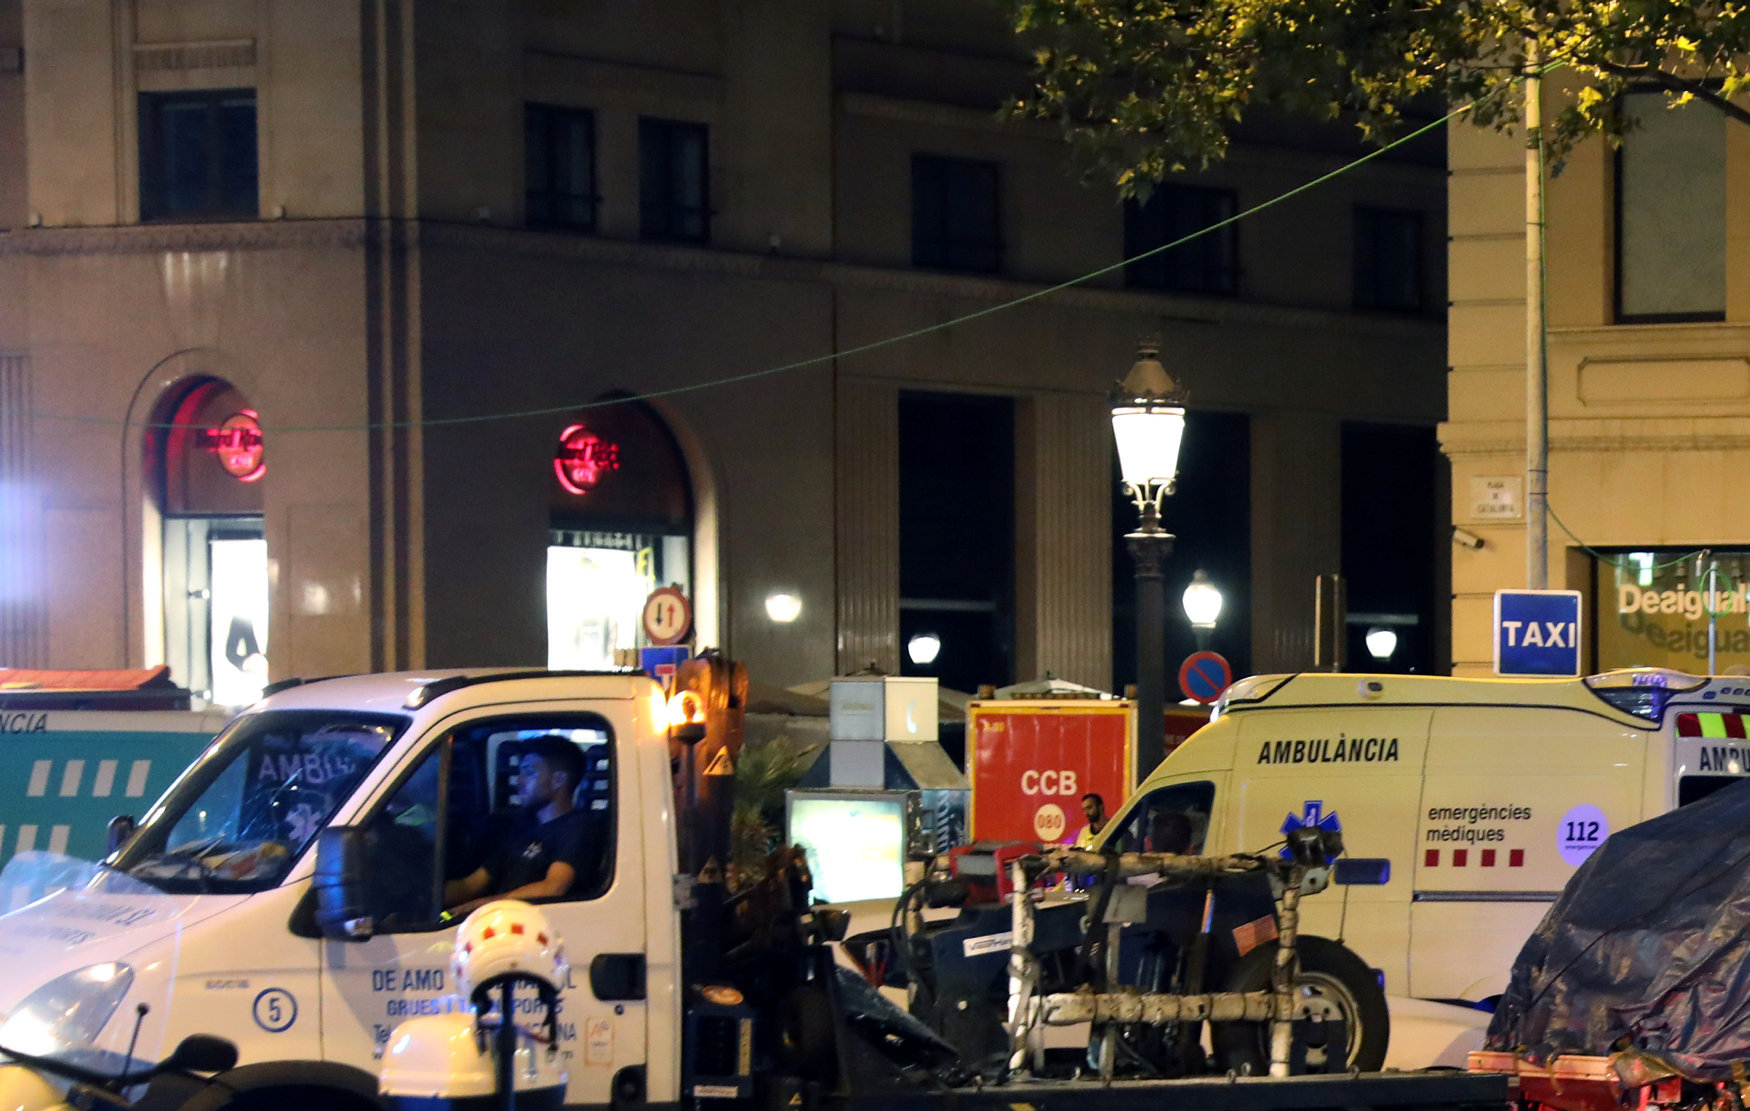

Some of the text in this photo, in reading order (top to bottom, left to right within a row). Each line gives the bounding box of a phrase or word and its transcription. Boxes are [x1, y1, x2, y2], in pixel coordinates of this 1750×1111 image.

[1502, 621, 1576, 648] TAXI
[1257, 733, 1399, 764] AMBULÀNCIA
[1021, 769, 1077, 795] CCB
[1037, 814, 1061, 829] 080
[1428, 804, 1531, 824] emergències
[1426, 825, 1505, 845] mèdiques
[1566, 822, 1599, 842] 112
[373, 969, 396, 990] DE
[403, 969, 444, 990] AMO
[268, 997, 282, 1022] 5
[387, 999, 440, 1016] GRUES
